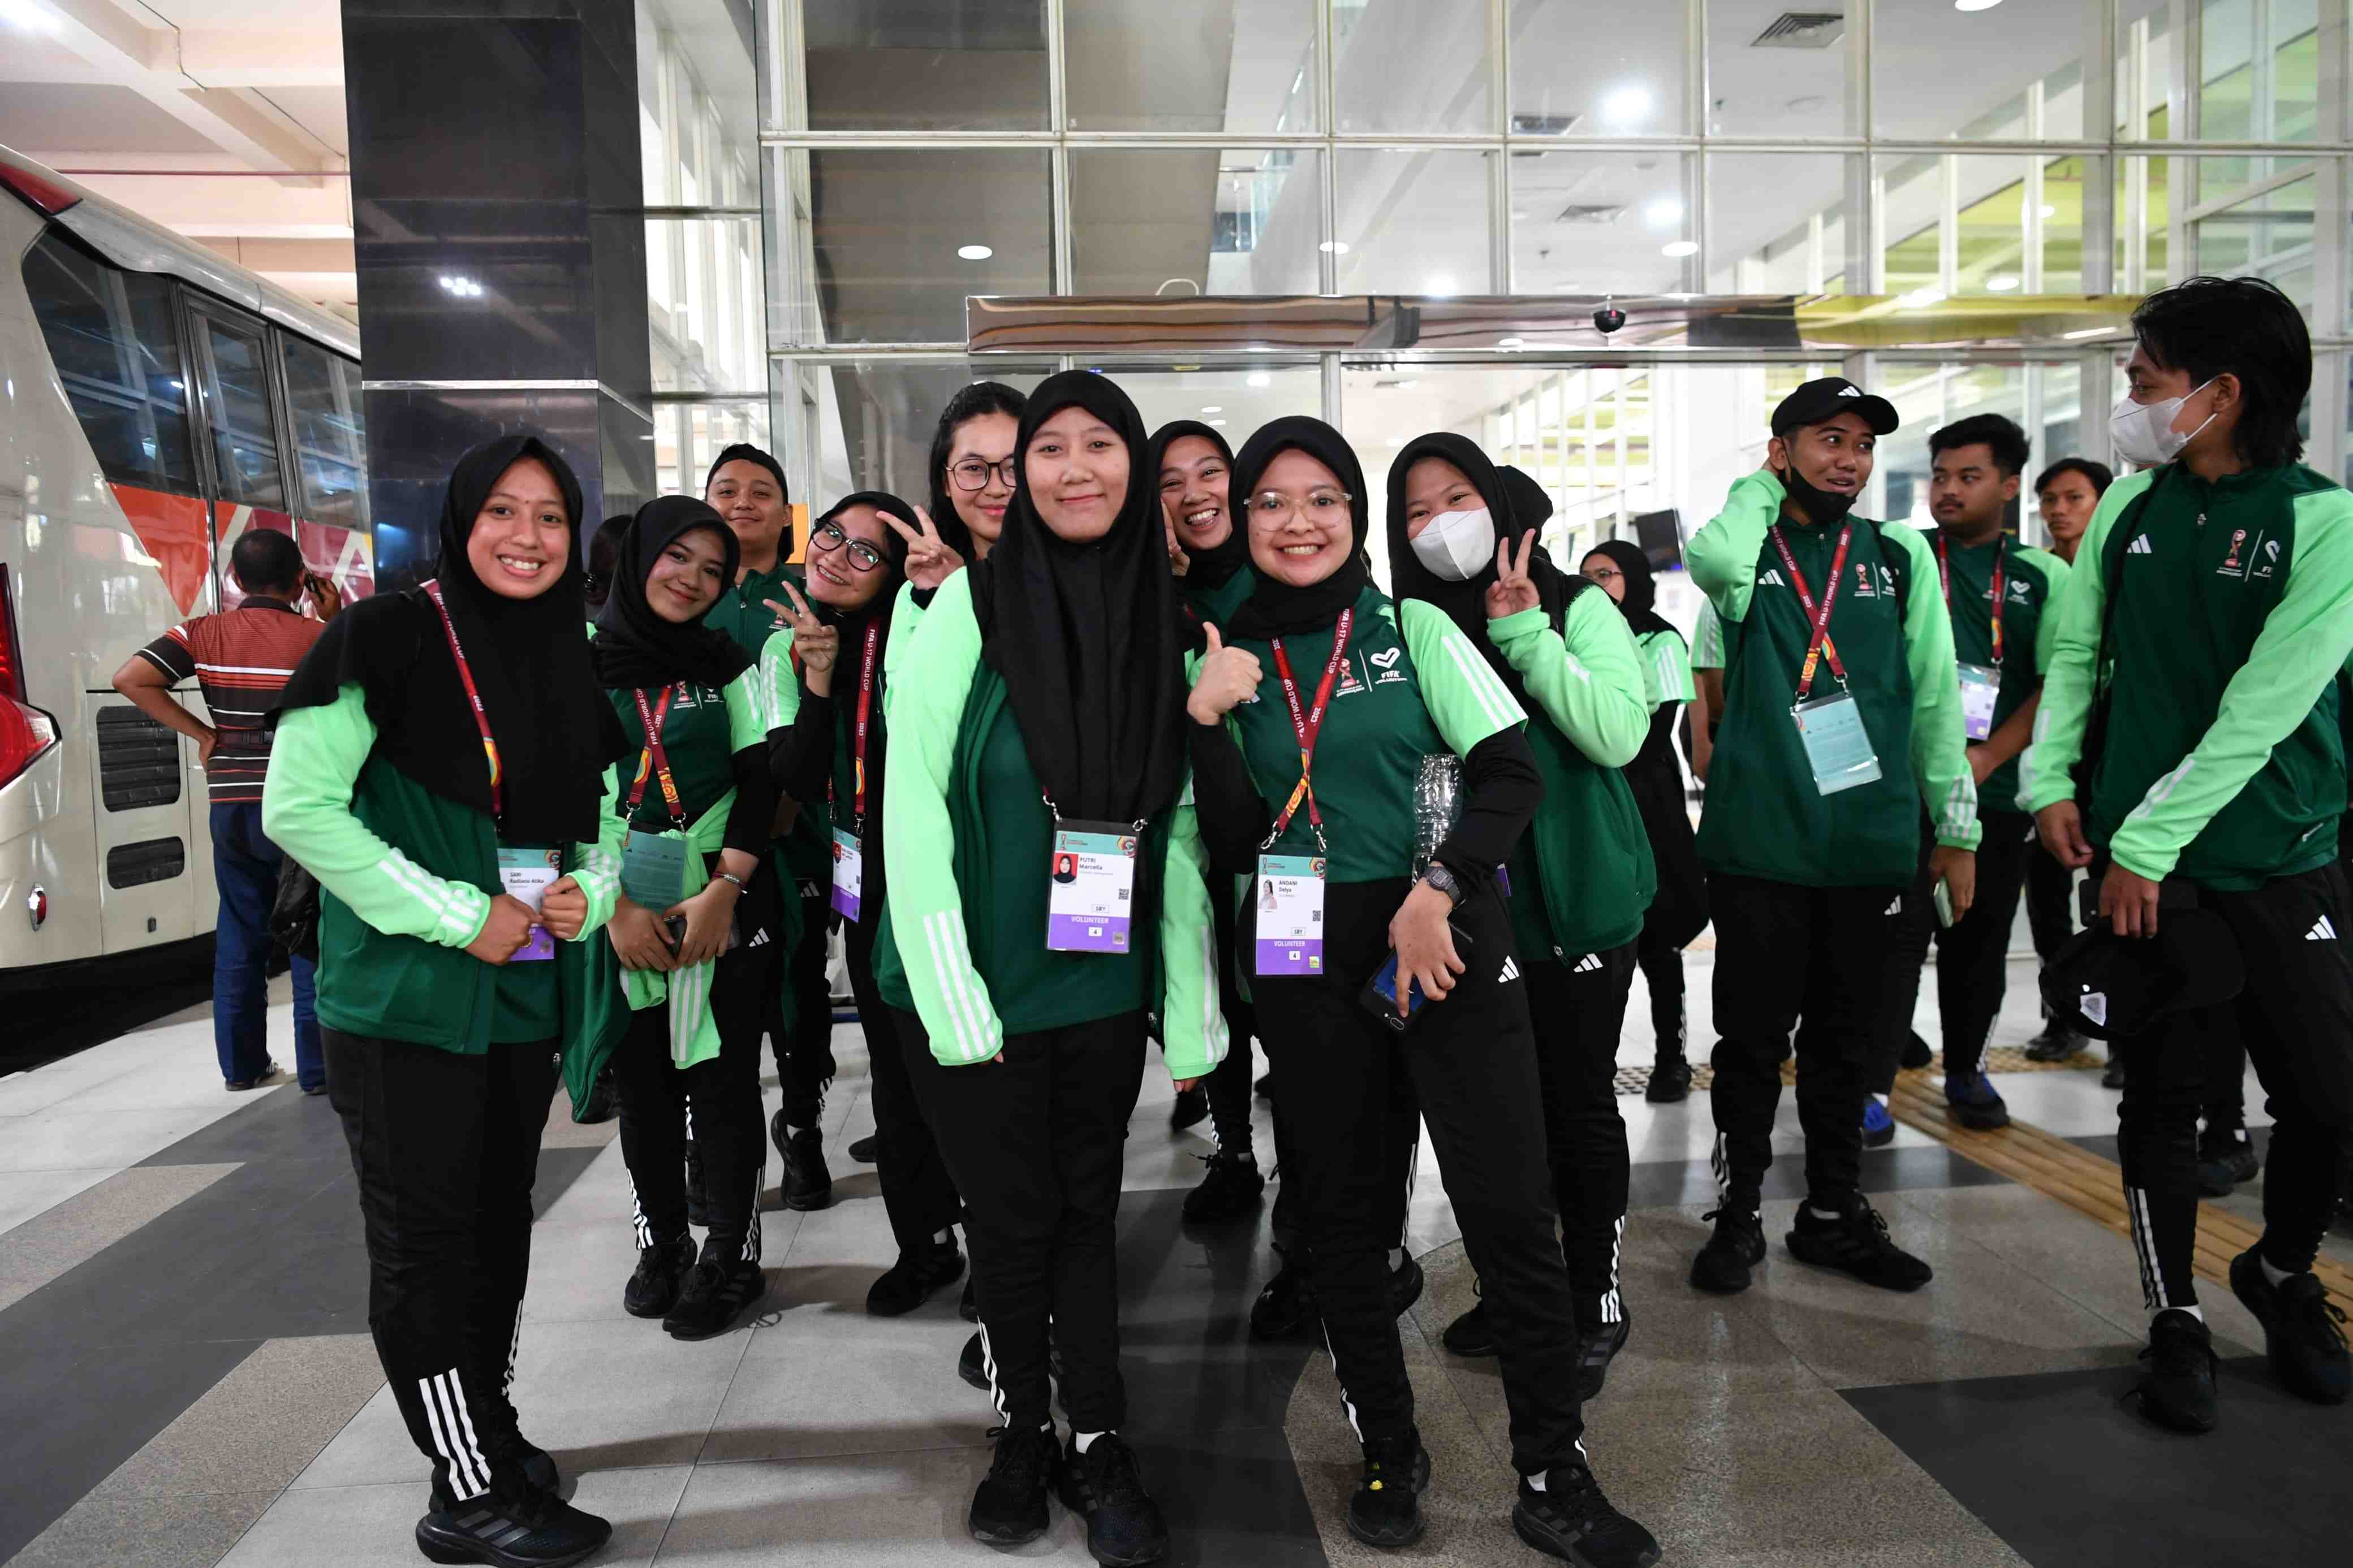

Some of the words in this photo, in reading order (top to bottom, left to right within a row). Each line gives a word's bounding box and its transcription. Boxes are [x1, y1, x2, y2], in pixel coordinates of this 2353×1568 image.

[1818, 612, 1828, 626] FIFA
[1826, 581, 1836, 601] WORLD
[1339, 622, 1348, 637] U-17
[1333, 638, 1344, 660] WORLD
[1329, 662, 1337, 674] CUP
[1381, 670, 1399, 679] FIFA
[1284, 679, 1293, 690] CUP
[640, 699, 650, 718] WORLD
[1288, 690, 1300, 713] WORLD
[1294, 714, 1304, 728] U-17
[1311, 707, 1321, 723] 2023
[645, 719, 654, 731] U-17
